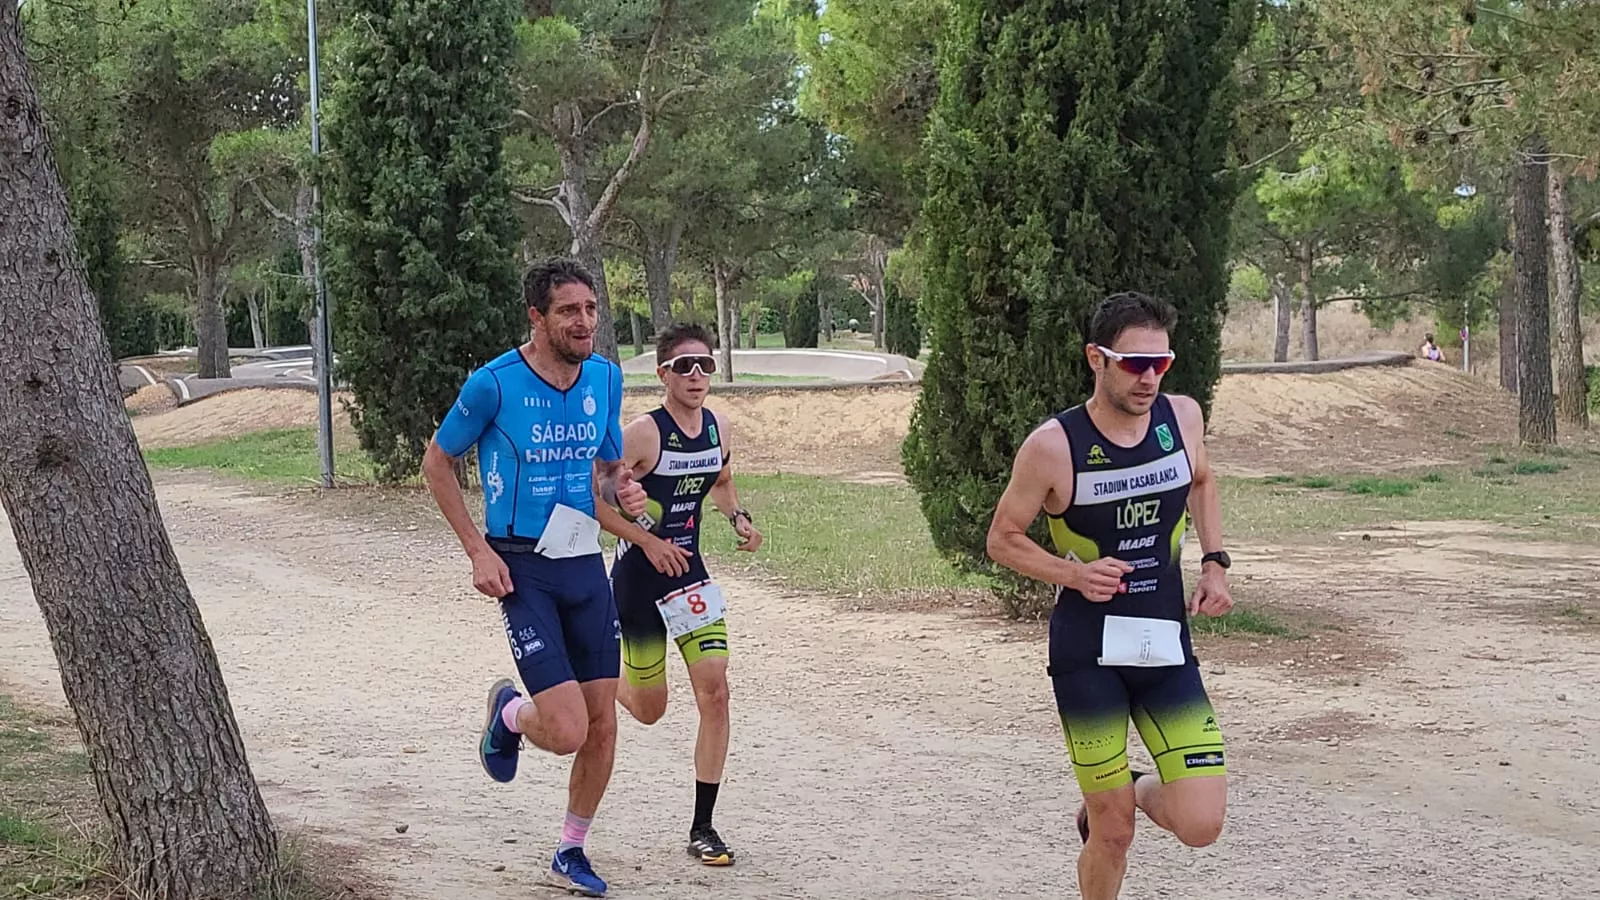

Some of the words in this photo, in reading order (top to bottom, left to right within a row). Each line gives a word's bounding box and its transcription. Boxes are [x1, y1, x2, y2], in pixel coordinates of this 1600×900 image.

[531, 419, 597, 443] SÁBADO
[525, 446, 598, 463] HINACO
[673, 475, 705, 497] LÓPEZ
[1094, 481, 1129, 496] STADIUM
[1130, 466, 1179, 490] CASABLANCA
[670, 502, 697, 513] MAPEI
[1116, 498, 1161, 529] LÓPEZ
[1118, 534, 1159, 551] MAPEI
[687, 593, 707, 614] 8
